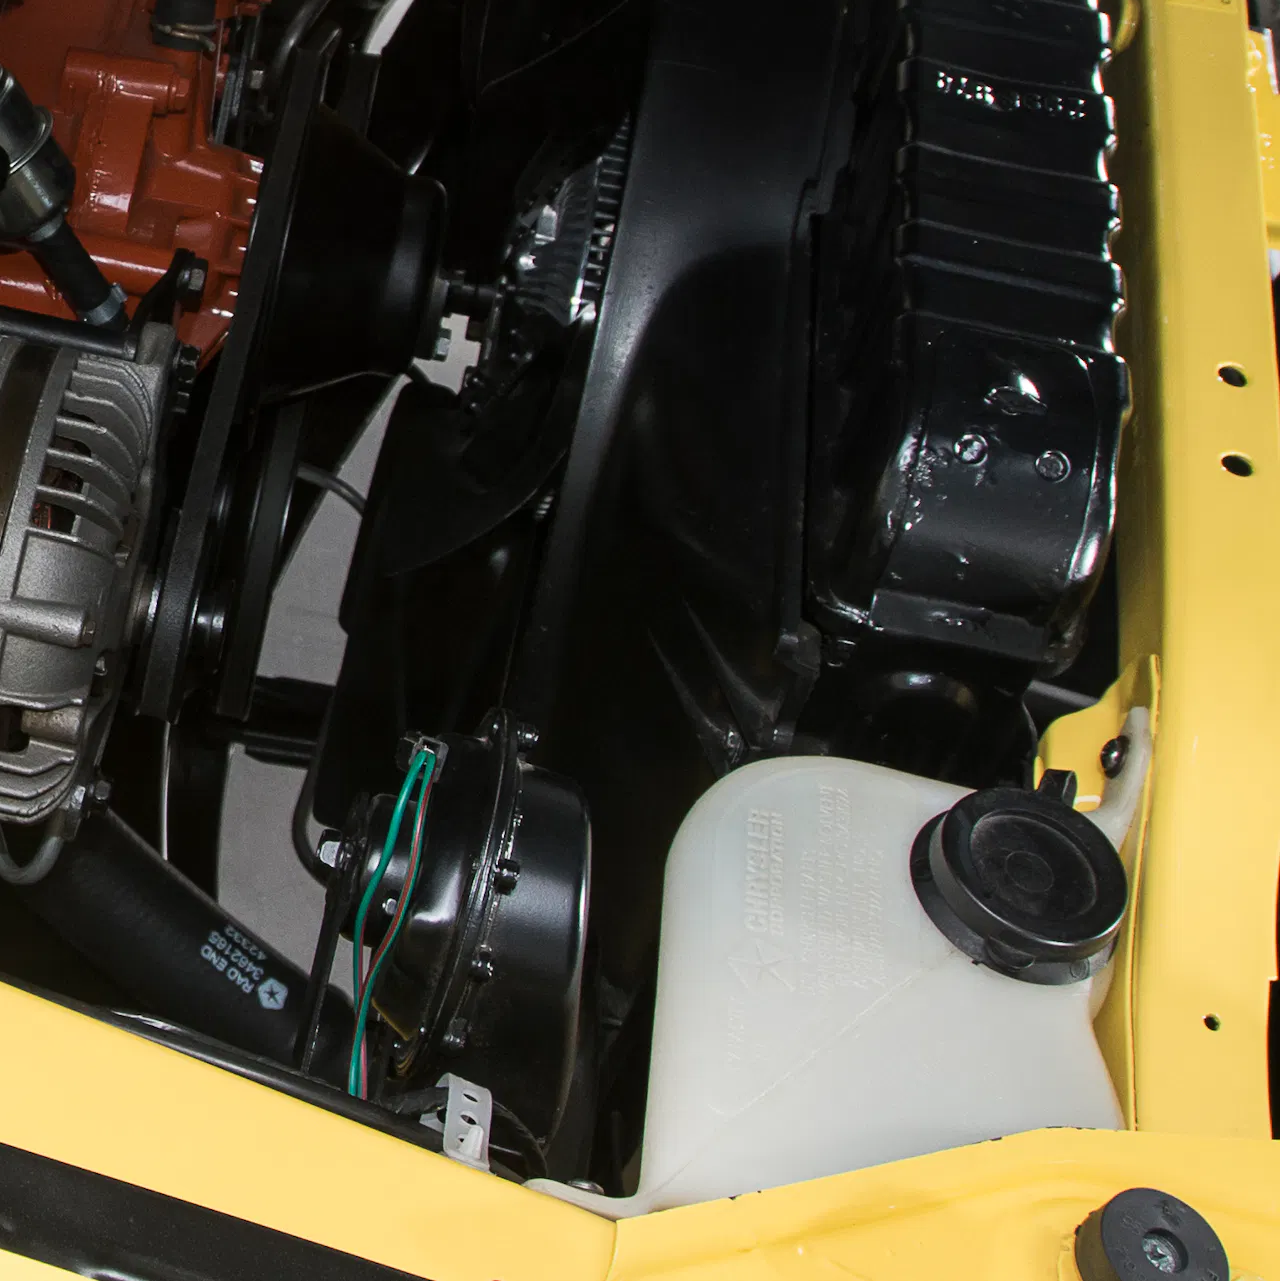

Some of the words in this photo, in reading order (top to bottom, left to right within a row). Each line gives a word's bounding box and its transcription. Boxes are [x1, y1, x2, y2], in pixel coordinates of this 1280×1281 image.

[744, 807, 770, 933] CHRYSLER
[199, 944, 228, 972] END
[226, 966, 255, 994] RAD
